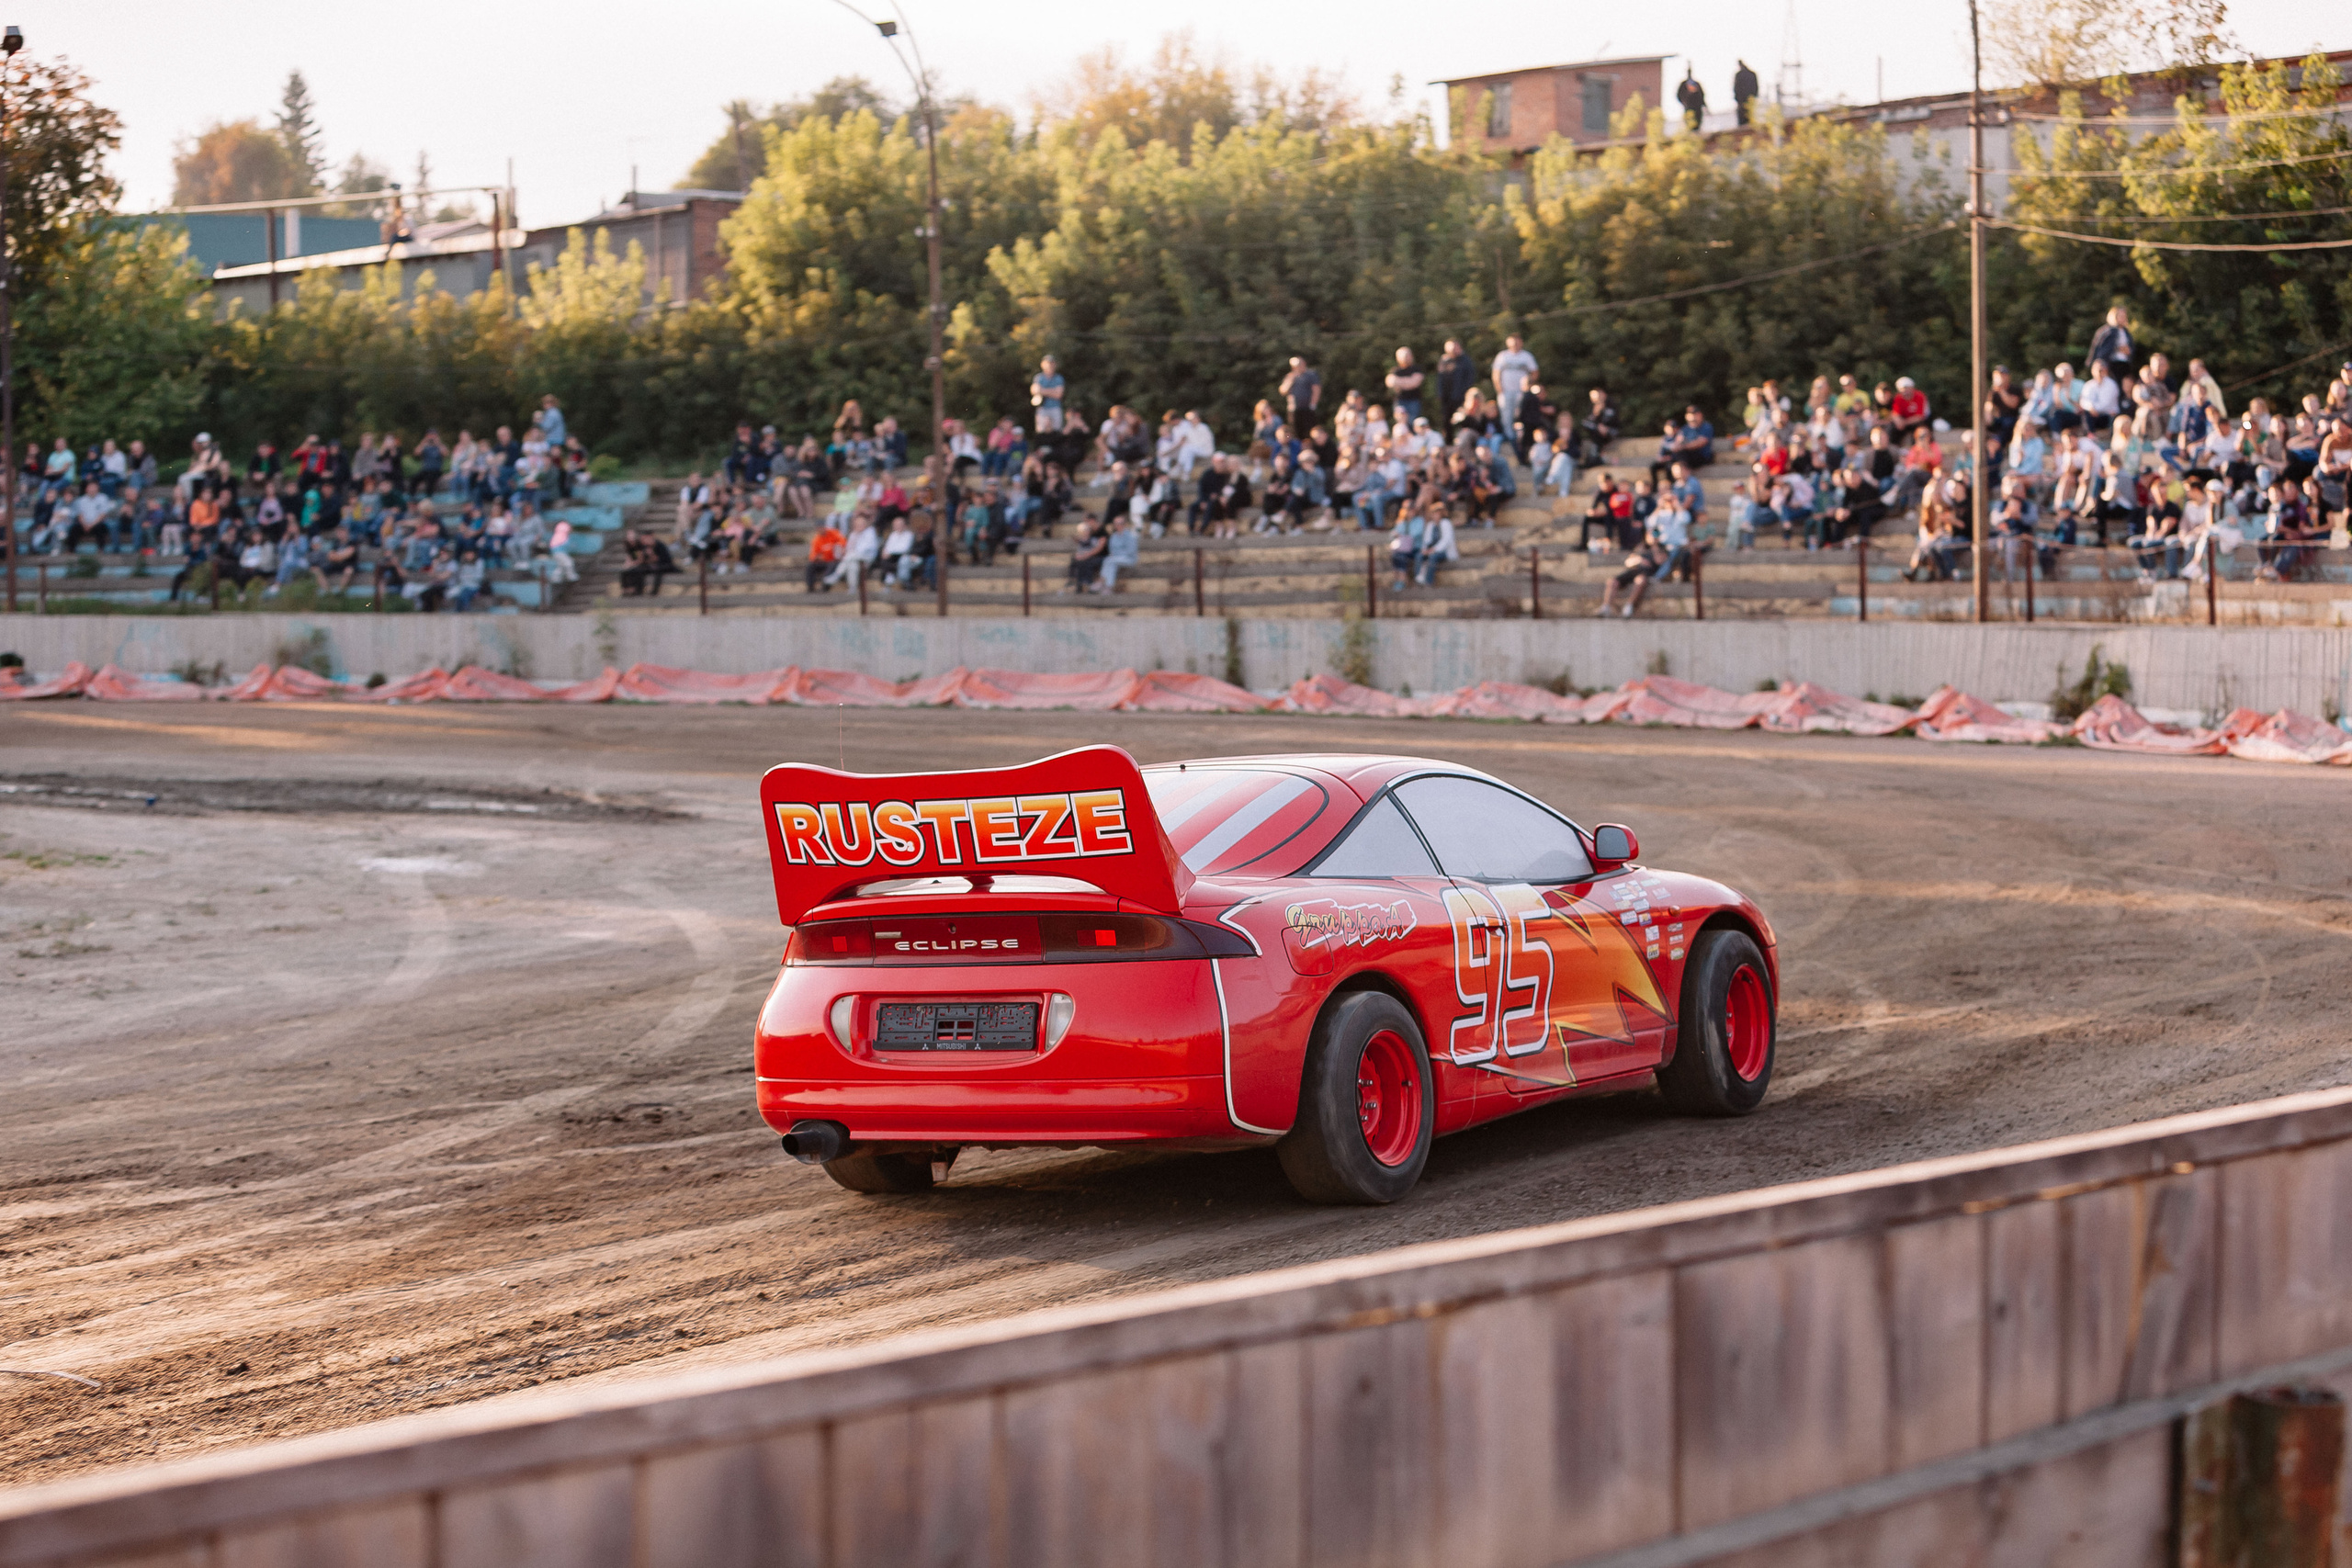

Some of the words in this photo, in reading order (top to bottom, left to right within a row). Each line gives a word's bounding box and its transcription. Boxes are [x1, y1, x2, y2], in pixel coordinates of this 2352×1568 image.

[774, 787, 1136, 867] RUSTEZE
[894, 938, 1019, 952] ECLIPSE
[1442, 883, 1555, 1068] 95
